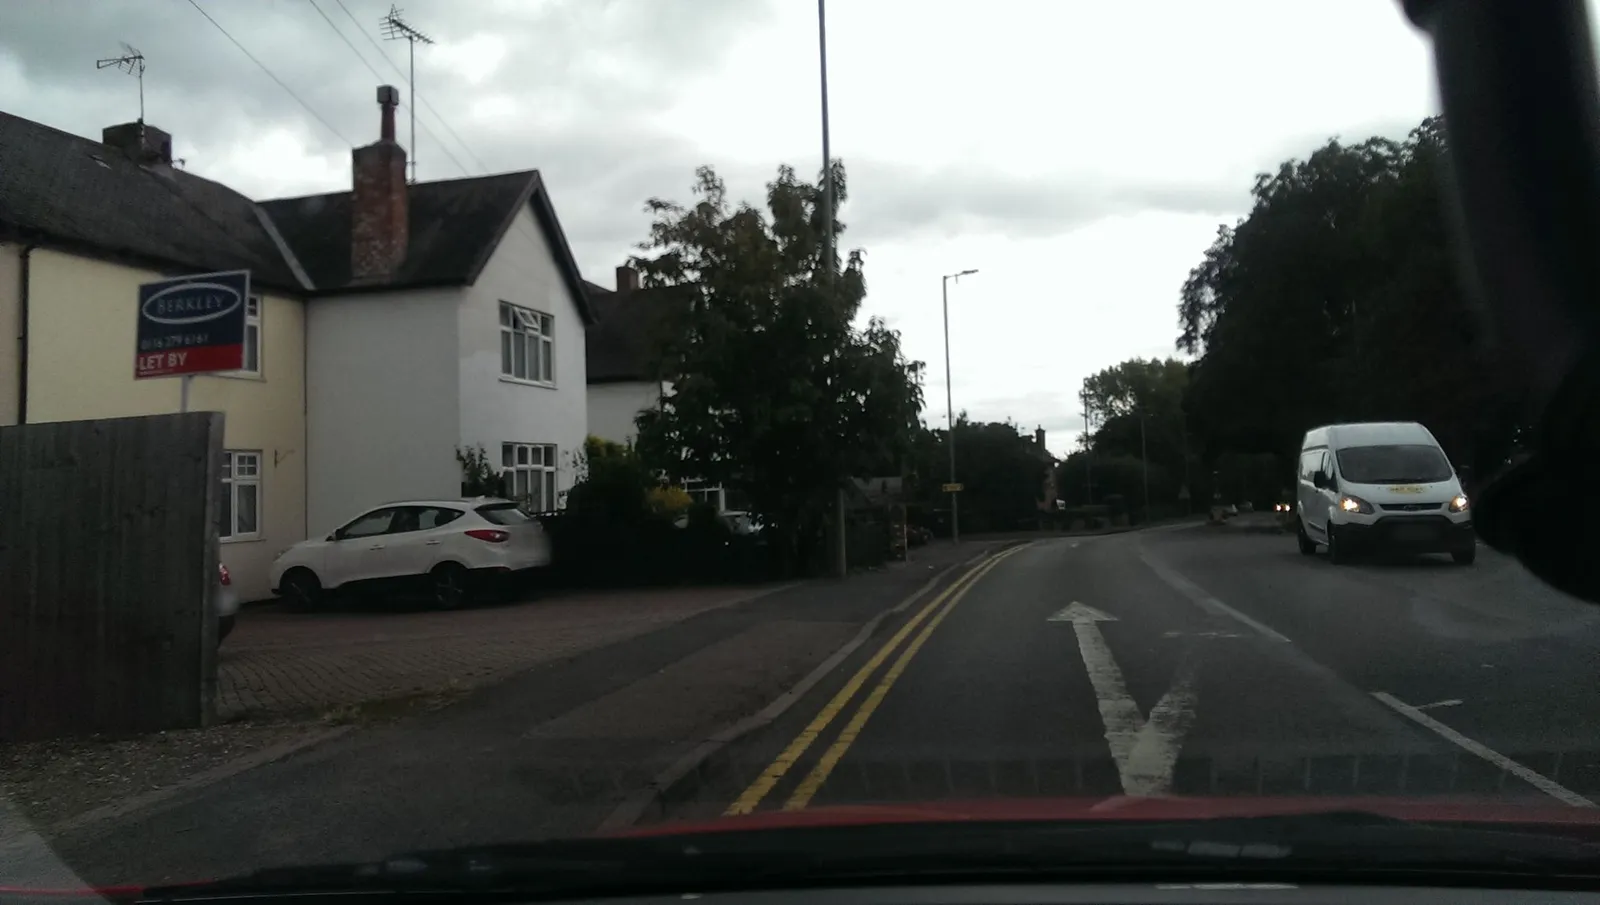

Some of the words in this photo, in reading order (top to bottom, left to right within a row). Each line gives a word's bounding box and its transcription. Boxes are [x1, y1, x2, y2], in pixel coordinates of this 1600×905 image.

[157, 295, 224, 314] BERKLEY
[139, 354, 164, 370] LET
[167, 352, 187, 367] BY
